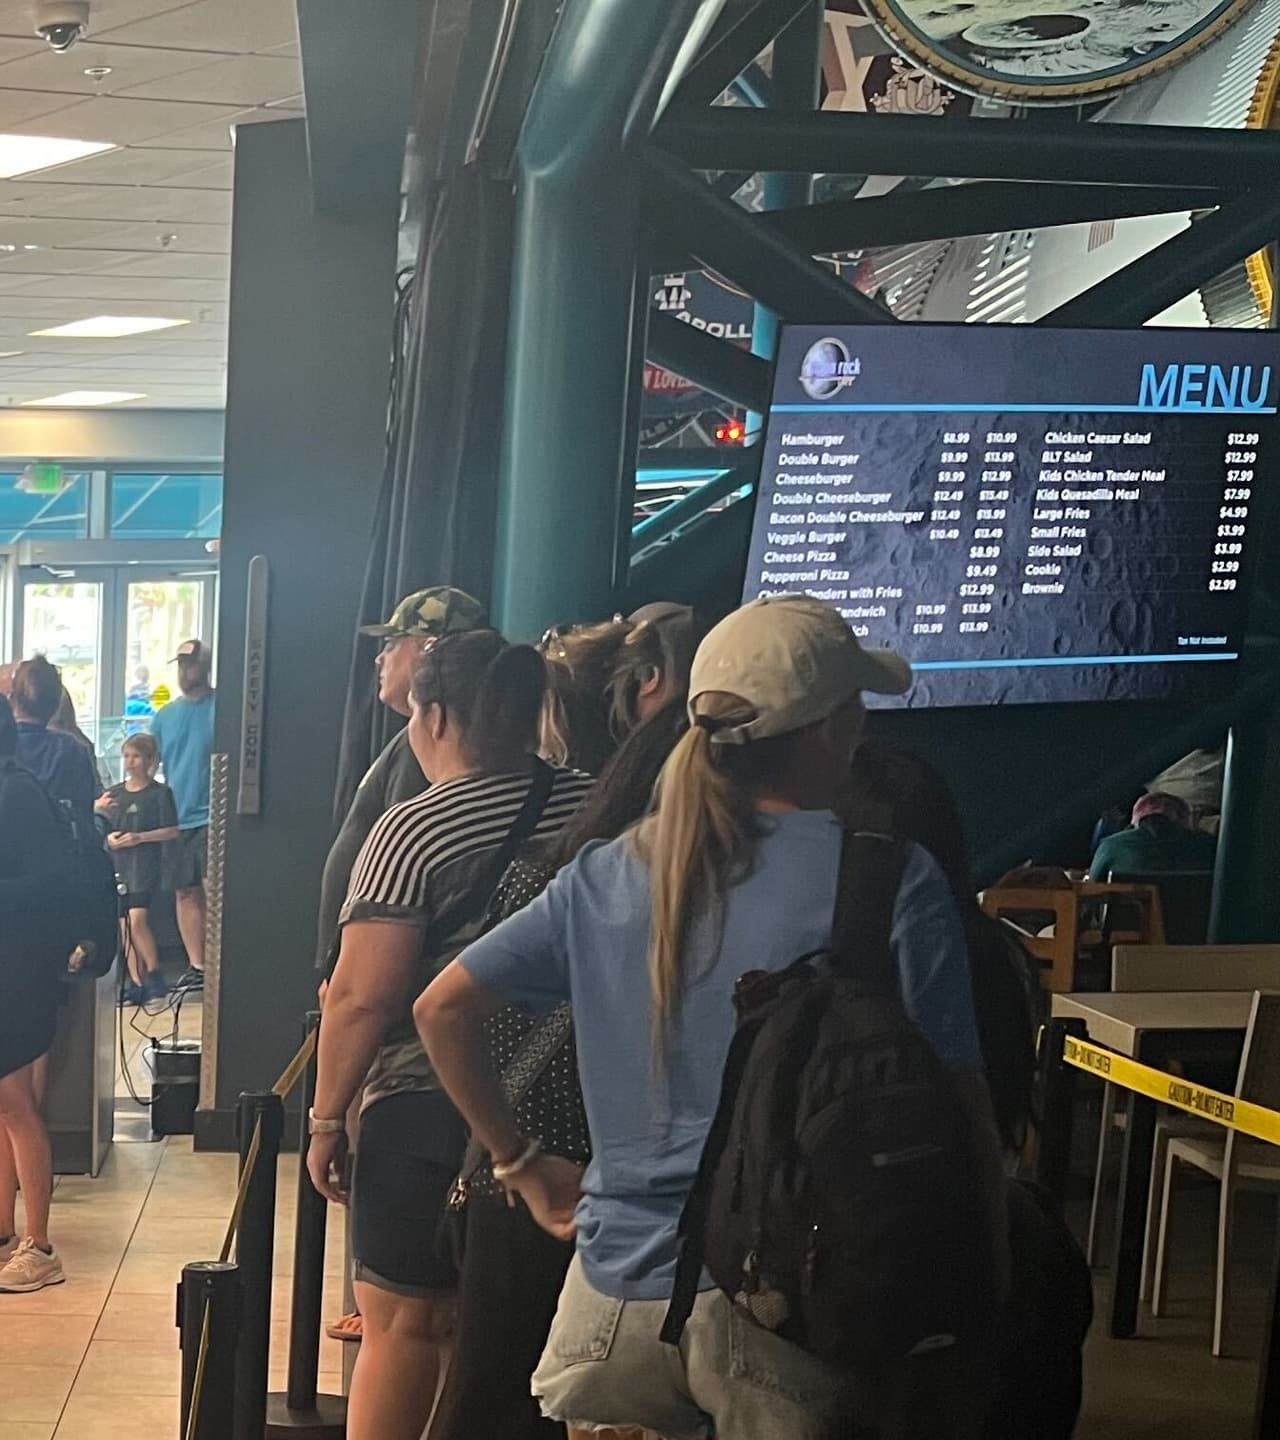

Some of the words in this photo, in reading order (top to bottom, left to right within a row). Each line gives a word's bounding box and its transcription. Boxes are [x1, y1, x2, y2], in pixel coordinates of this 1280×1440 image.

[1138, 364, 1271, 410] MENU
[781, 433, 844, 447] Hamburger
[943, 432, 970, 444] $8.99
[986, 432, 1017, 444] $10.99
[1045, 432, 1085, 445] Chicken
[1087, 433, 1122, 445] Caesar
[1123, 432, 1151, 445] Salad
[1227, 433, 1259, 445] $12.99
[778, 453, 819, 466] Double
[821, 452, 859, 466] Burger
[941, 451, 968, 463] $9.99
[1042, 451, 1062, 463] BLT
[1063, 451, 1092, 463] Salad
[1225, 451, 1256, 463] $12.99
[775, 473, 853, 487] Cheeseburger
[938, 471, 965, 483] $9.99
[981, 470, 1012, 483] $12.99
[1039, 470, 1062, 482] Kids
[1064, 470, 1104, 482] Chicken
[1106, 470, 1140, 482] Tender
[1141, 470, 1165, 482] Meal
[1227, 470, 1254, 482] $7.99
[772, 493, 813, 505] Double
[815, 491, 892, 505] Cheeseburger
[934, 490, 964, 503] $12.49
[1036, 489, 1059, 500] Kids
[1061, 488, 1114, 501] Quesadilla
[1115, 488, 1140, 500] Meal
[1224, 489, 1251, 500] $7.99
[770, 513, 804, 525] Bacon
[807, 511, 847, 524] Double
[849, 510, 925, 525] Cheeseburger
[931, 509, 961, 522] $12.49
[1033, 508, 1063, 522] Large
[1065, 508, 1090, 519] Fries
[1219, 506, 1248, 518] $4.99
[767, 532, 806, 546] Veggie
[808, 531, 847, 544] Burger
[1031, 526, 1059, 538] Small
[1060, 526, 1087, 538] Fries
[1217, 525, 1245, 537] $3.99
[764, 551, 804, 564] Cheese
[806, 551, 837, 563] Pizza
[969, 546, 1001, 558] $8.99
[1028, 545, 1051, 557] Side
[1052, 544, 1082, 556] Salad
[1214, 544, 1242, 555] $3.99
[761, 570, 818, 584] Pepperoni
[820, 569, 850, 581] Pizza
[966, 564, 998, 577] $9.49
[1024, 564, 1061, 576] Cookie
[1211, 561, 1239, 573] $2.99
[850, 588, 874, 599] with
[875, 586, 903, 599] Fries
[960, 584, 994, 596] $12.99
[1022, 582, 1064, 595] Brownie
[1209, 580, 1237, 592] $2.99
[915, 604, 946, 616] $10.99
